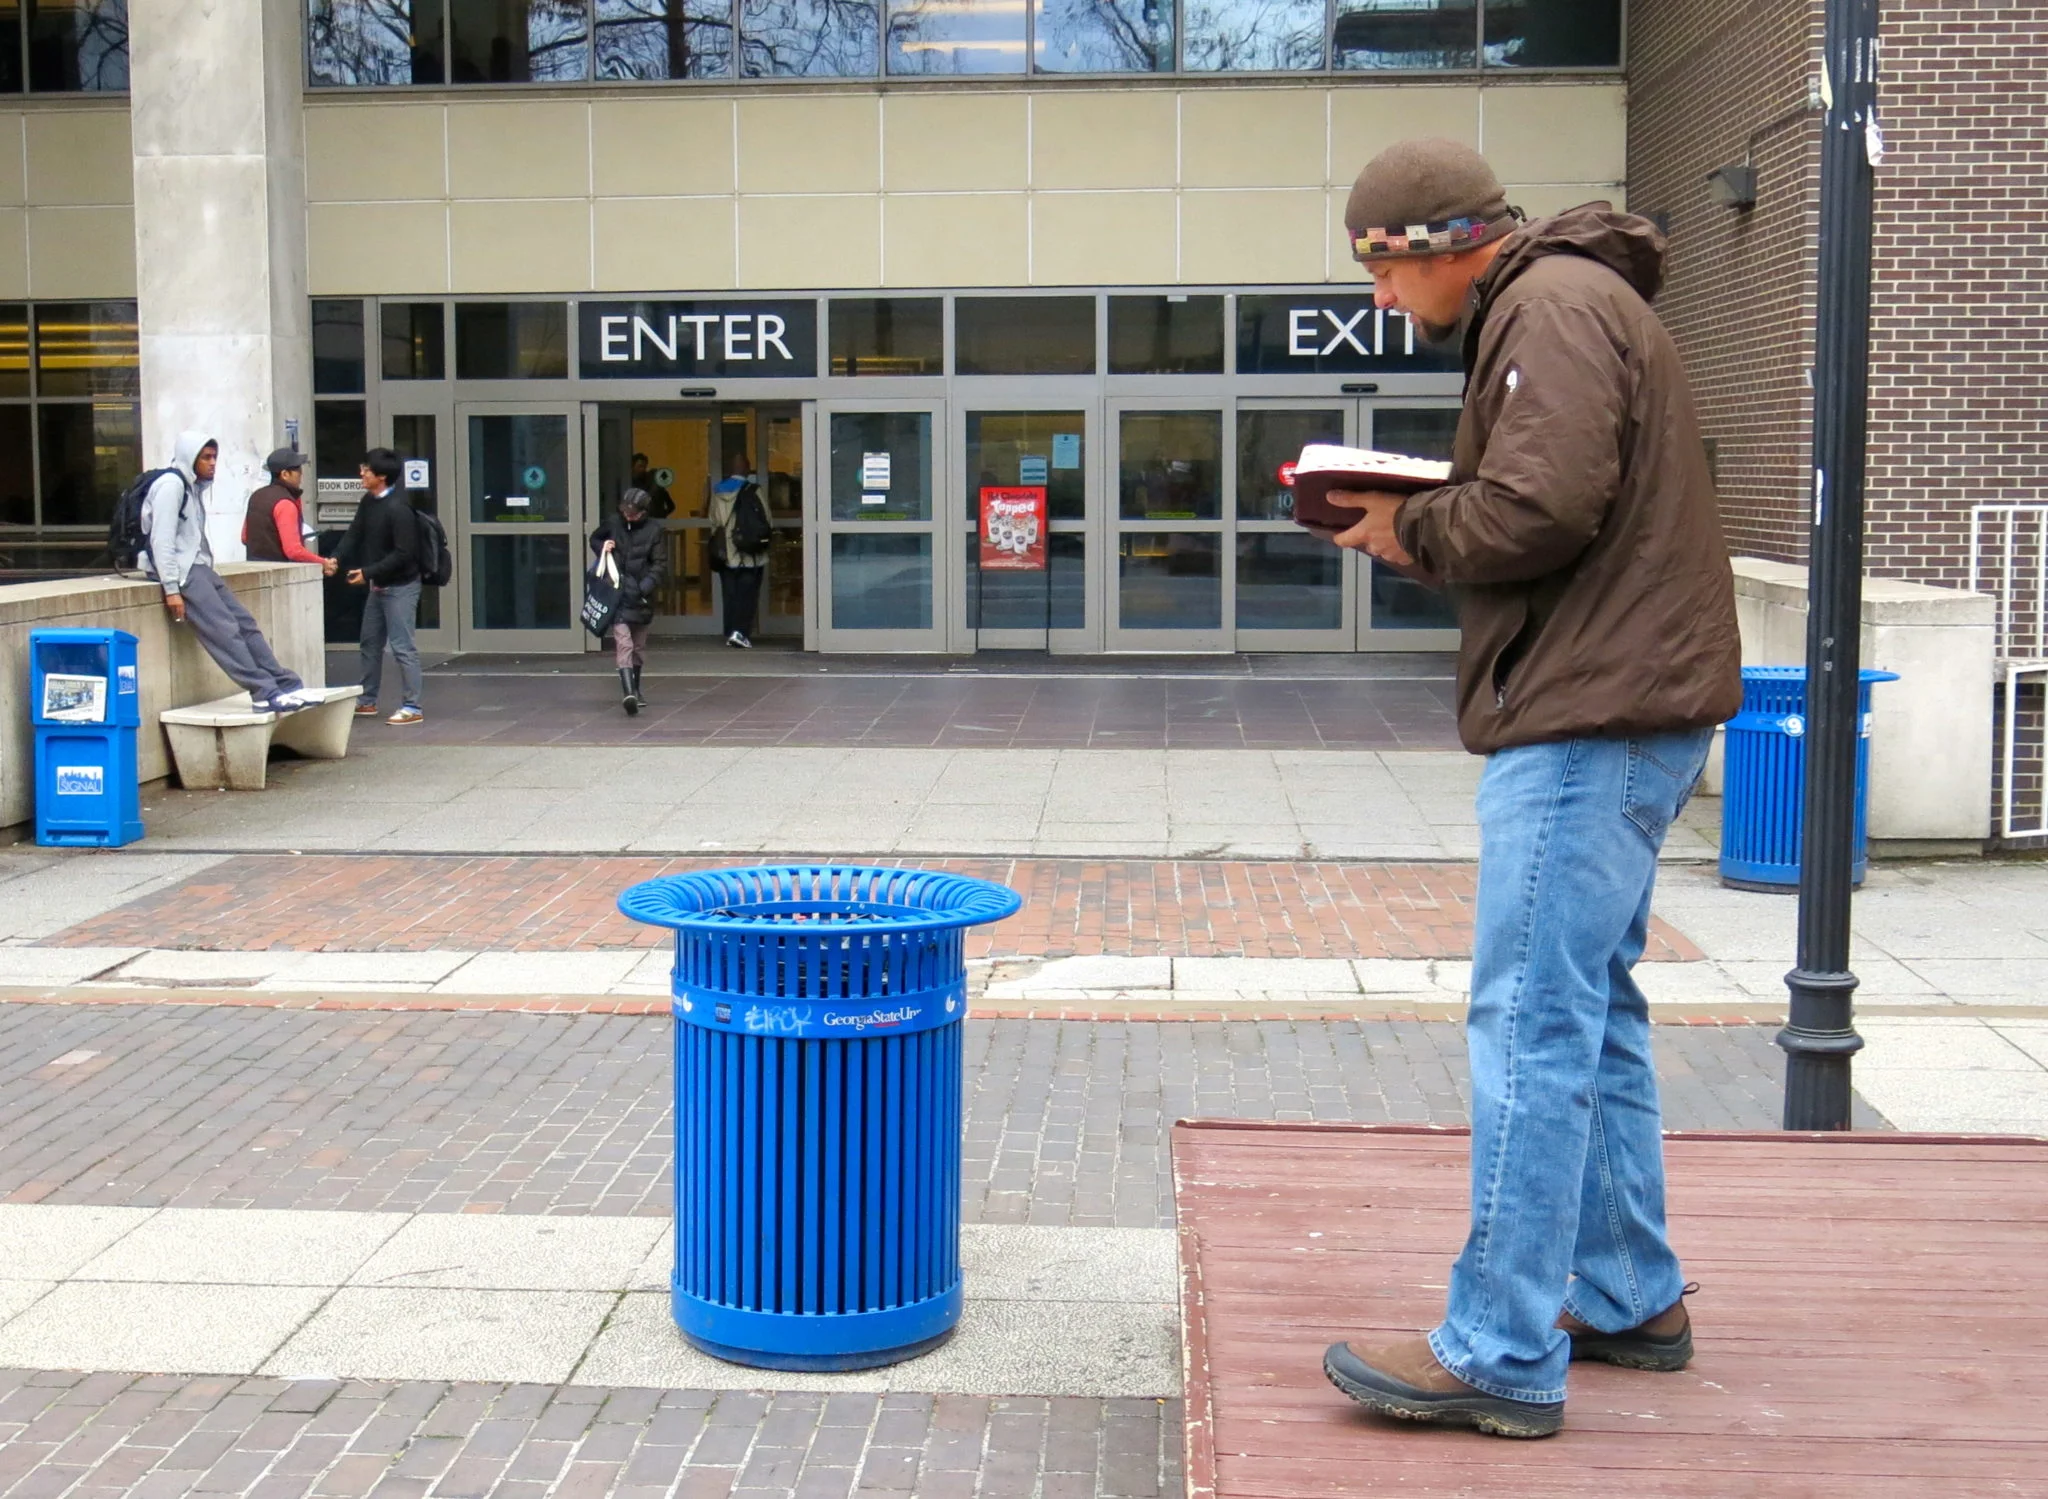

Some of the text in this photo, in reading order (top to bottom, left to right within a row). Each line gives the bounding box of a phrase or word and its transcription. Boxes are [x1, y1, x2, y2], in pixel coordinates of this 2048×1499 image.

[600, 314, 794, 361] ENTER
[1289, 309, 1414, 356] EXIT
[319, 481, 342, 490] BOOK
[60, 780, 100, 792] SIGNAL
